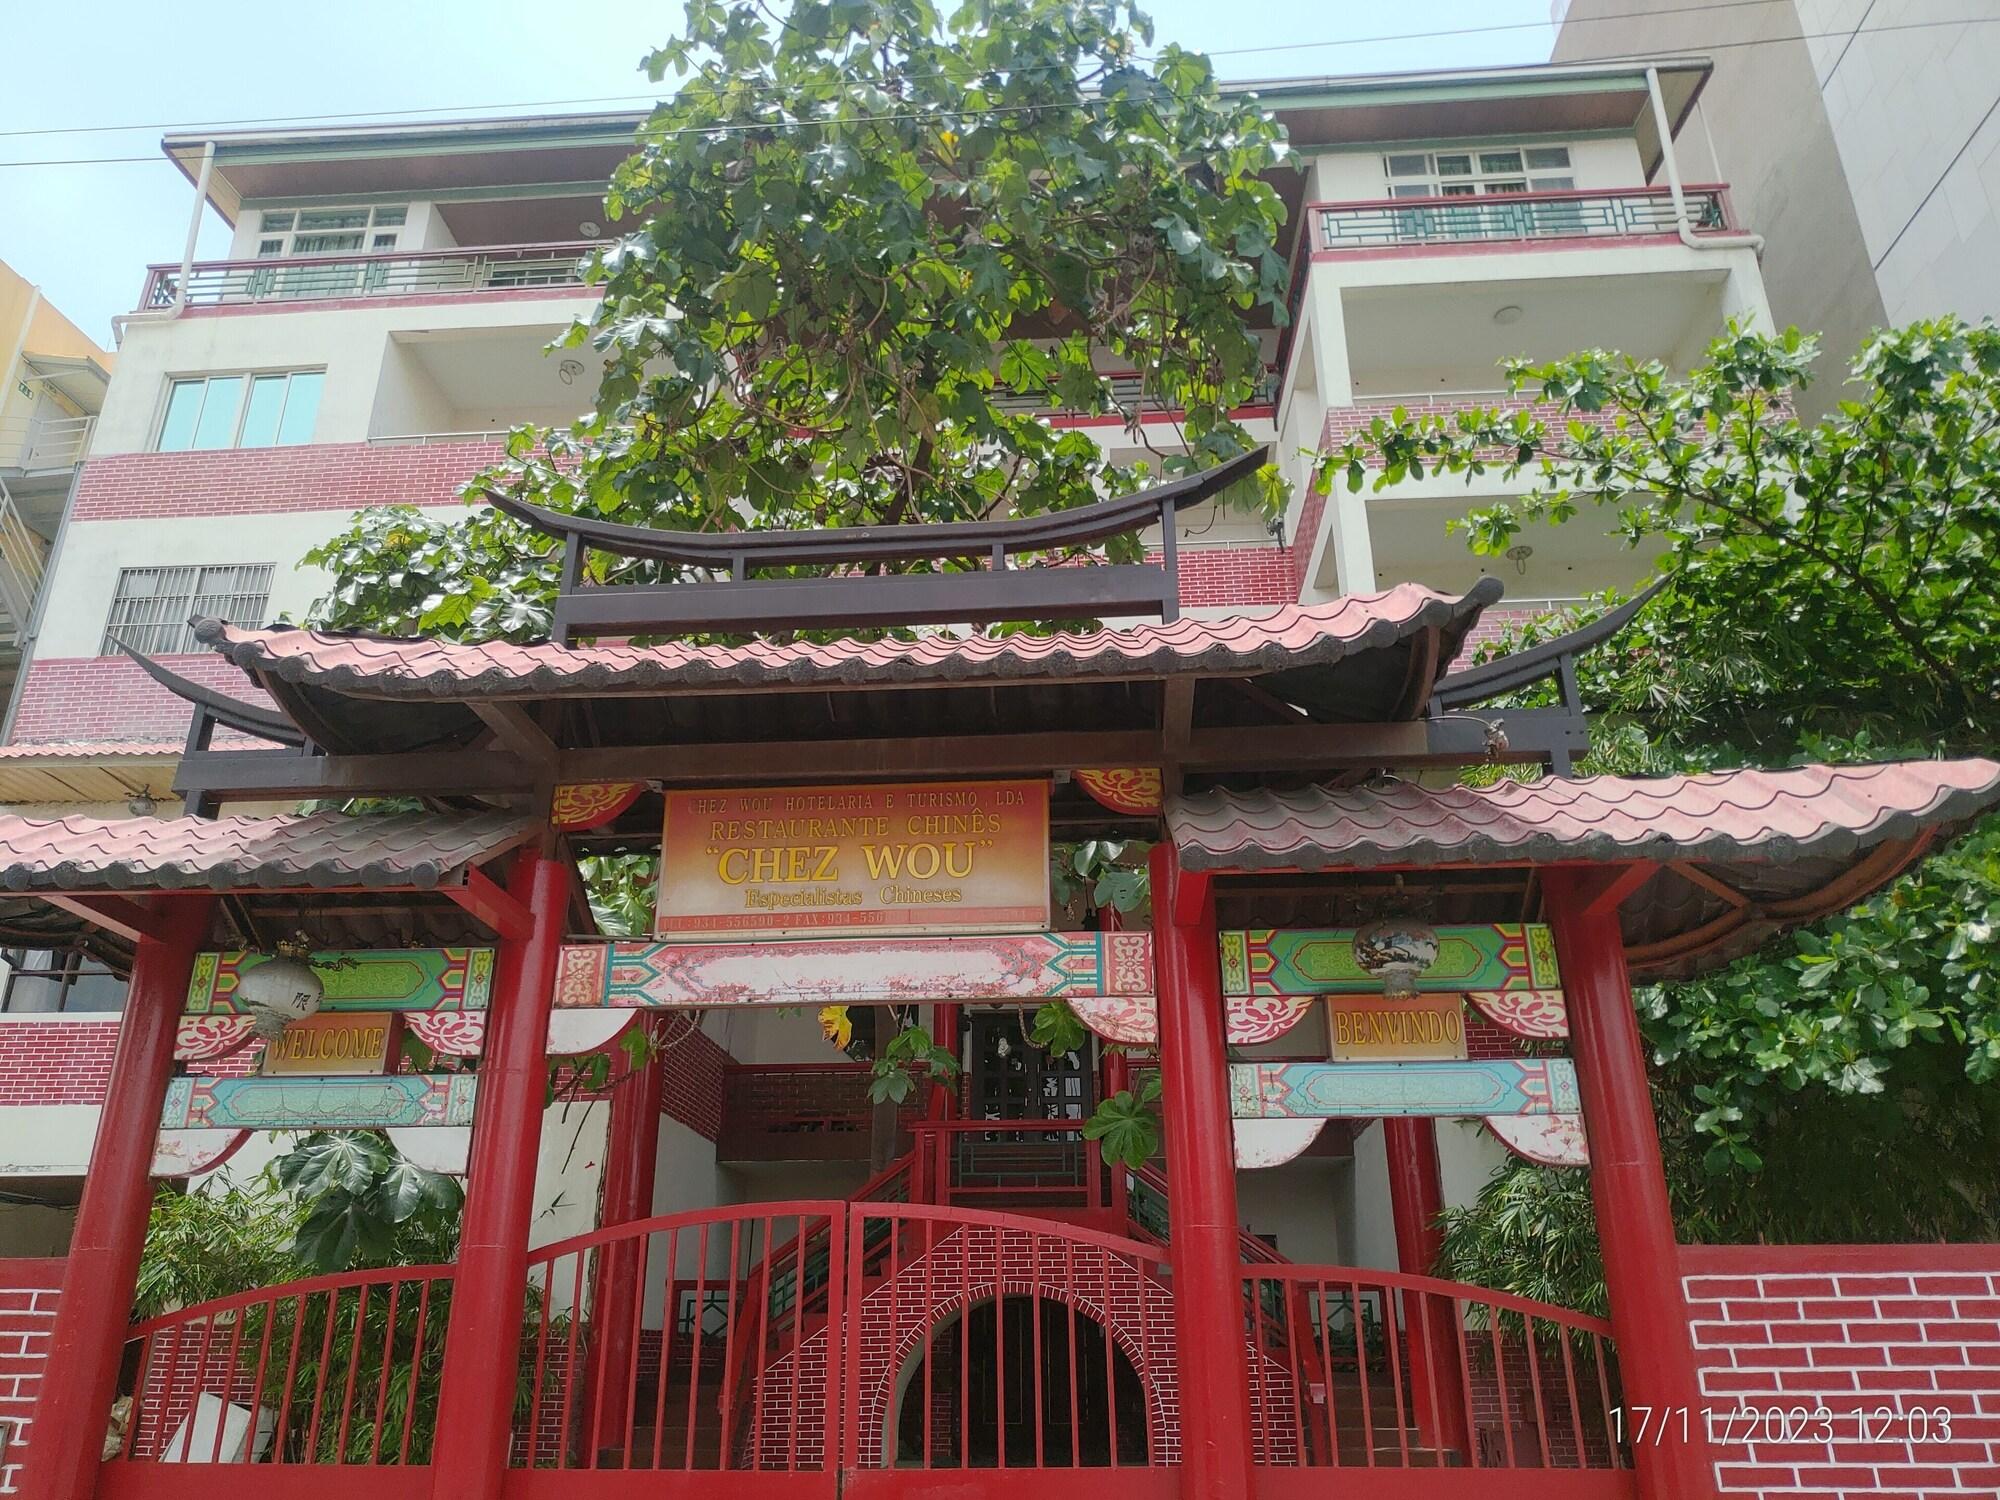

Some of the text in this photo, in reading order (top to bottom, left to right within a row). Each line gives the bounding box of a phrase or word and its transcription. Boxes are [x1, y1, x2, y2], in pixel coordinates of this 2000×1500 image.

[740, 797, 774, 813] WOU
[785, 794, 873, 812] HOTELARIA
[886, 794, 894, 808] E
[996, 790, 1025, 806] LDA
[710, 807, 1001, 841] RESTAURANTE CHINÊS
[744, 884, 962, 911] Especialistas Chineses
[274, 1027, 384, 1060] WELCOME
[1335, 1010, 1461, 1045] BENVINDO
